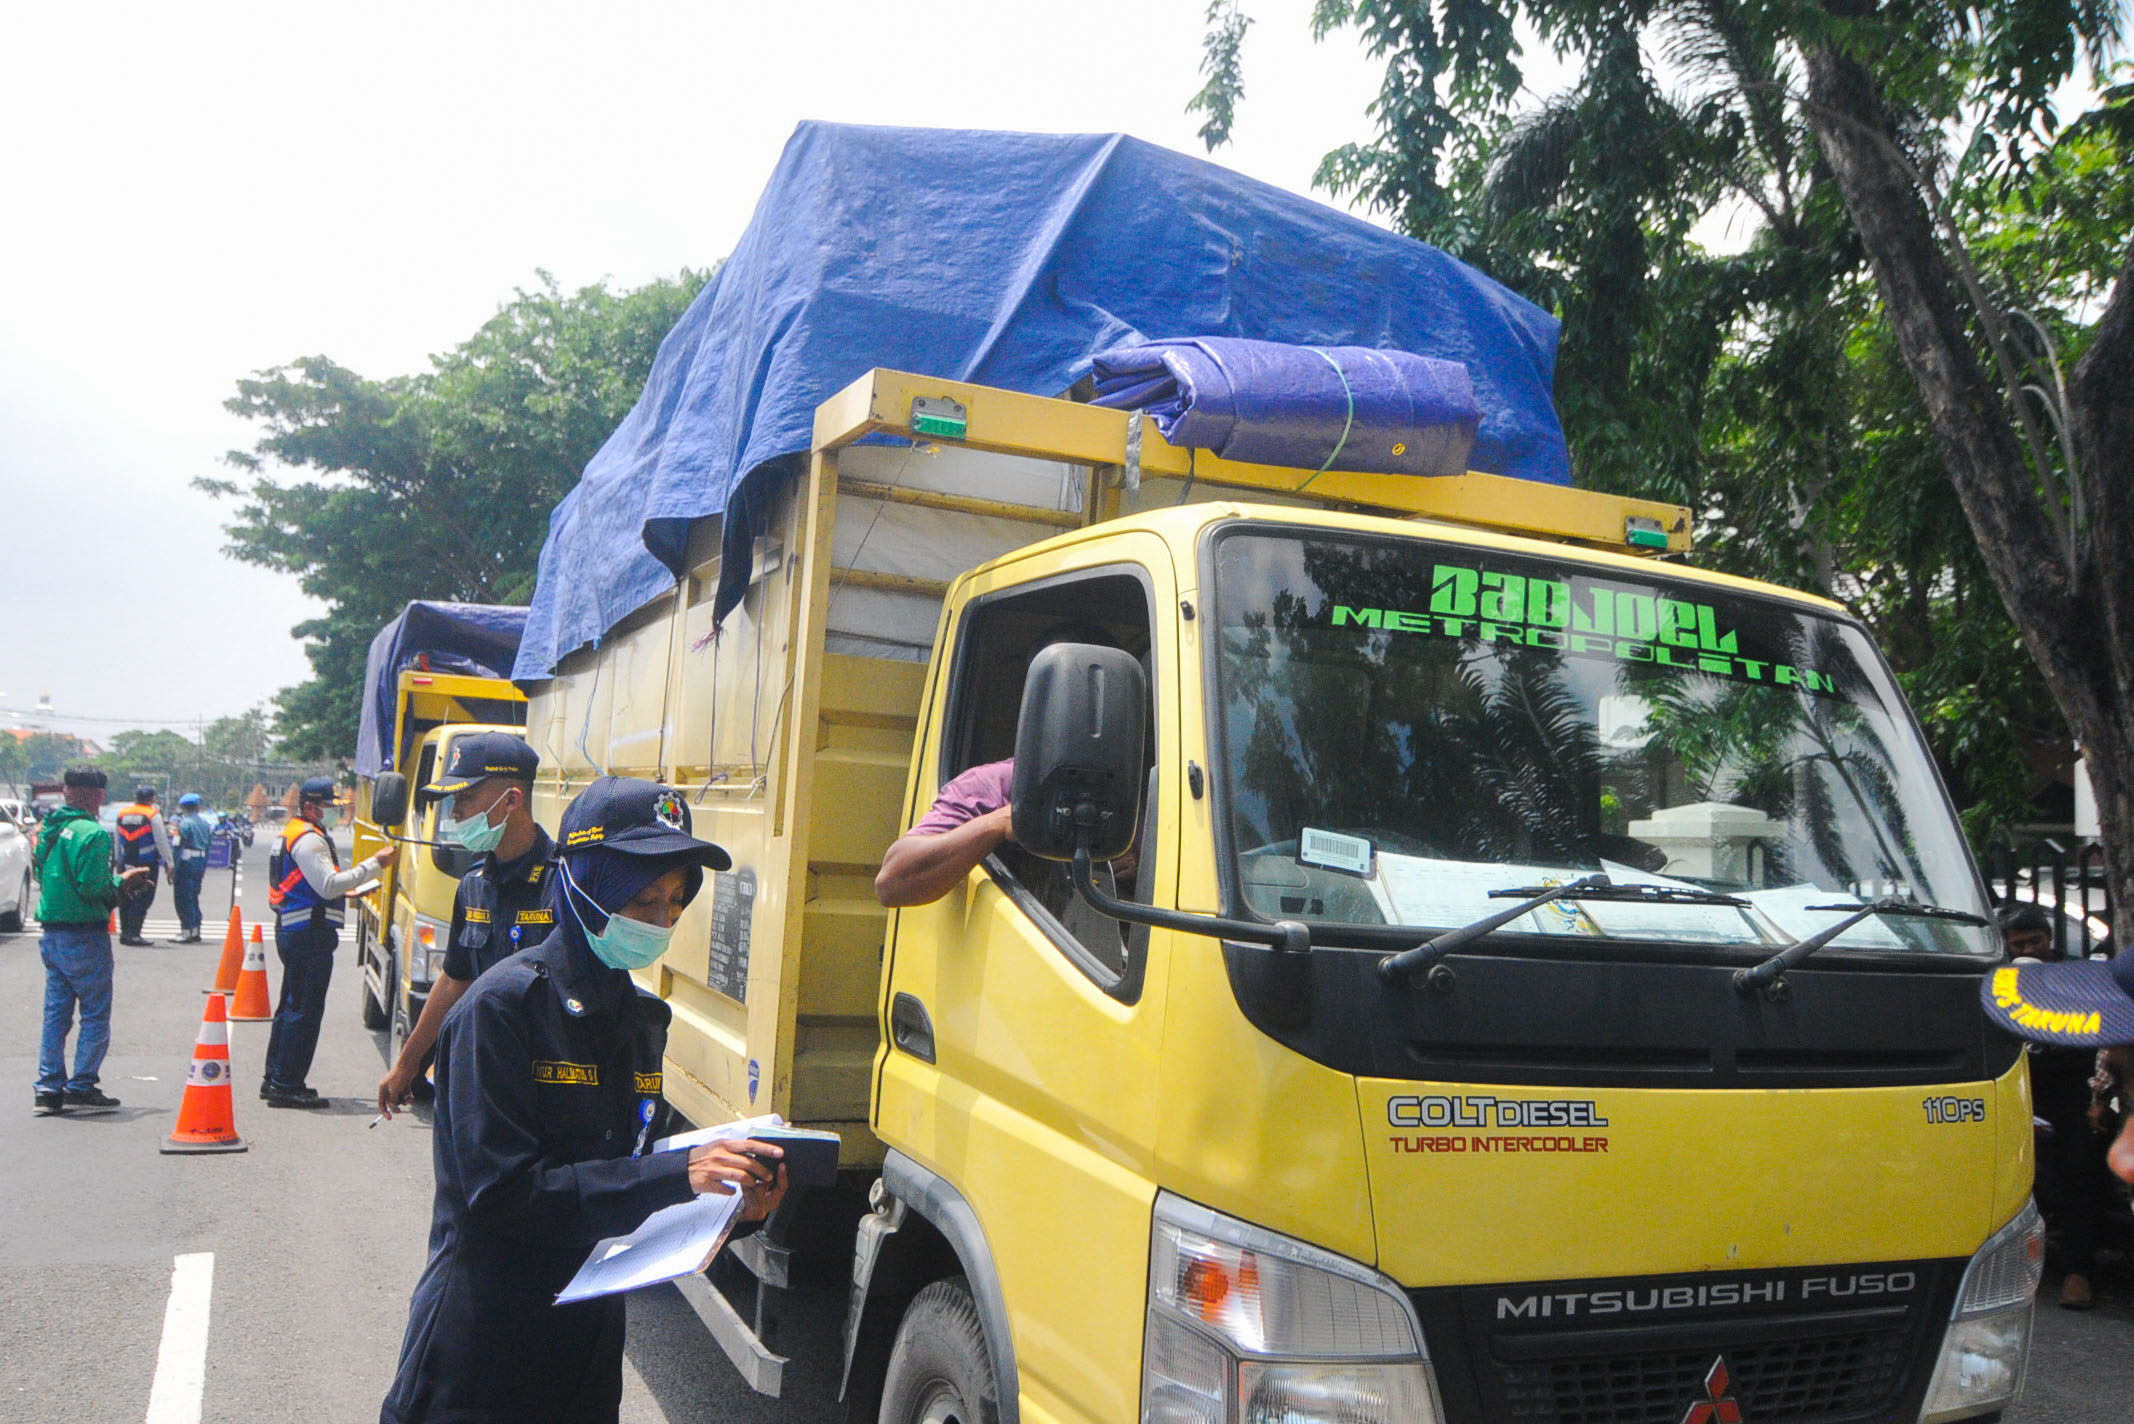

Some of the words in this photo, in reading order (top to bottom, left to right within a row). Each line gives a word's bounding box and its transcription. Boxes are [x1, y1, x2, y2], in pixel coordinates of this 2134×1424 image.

[519, 911, 550, 921] TARUNA
[2009, 1002, 2101, 1034] TARUNA
[634, 1076, 662, 1090] TARU
[1923, 1096, 1985, 1124] 110PS
[1389, 1137, 1467, 1153] TURBO
[1471, 1136, 1609, 1153] INTERCOOLER
[1497, 1280, 1785, 1319] MITSUBISHI
[1802, 1271, 1916, 1299] FUSO
